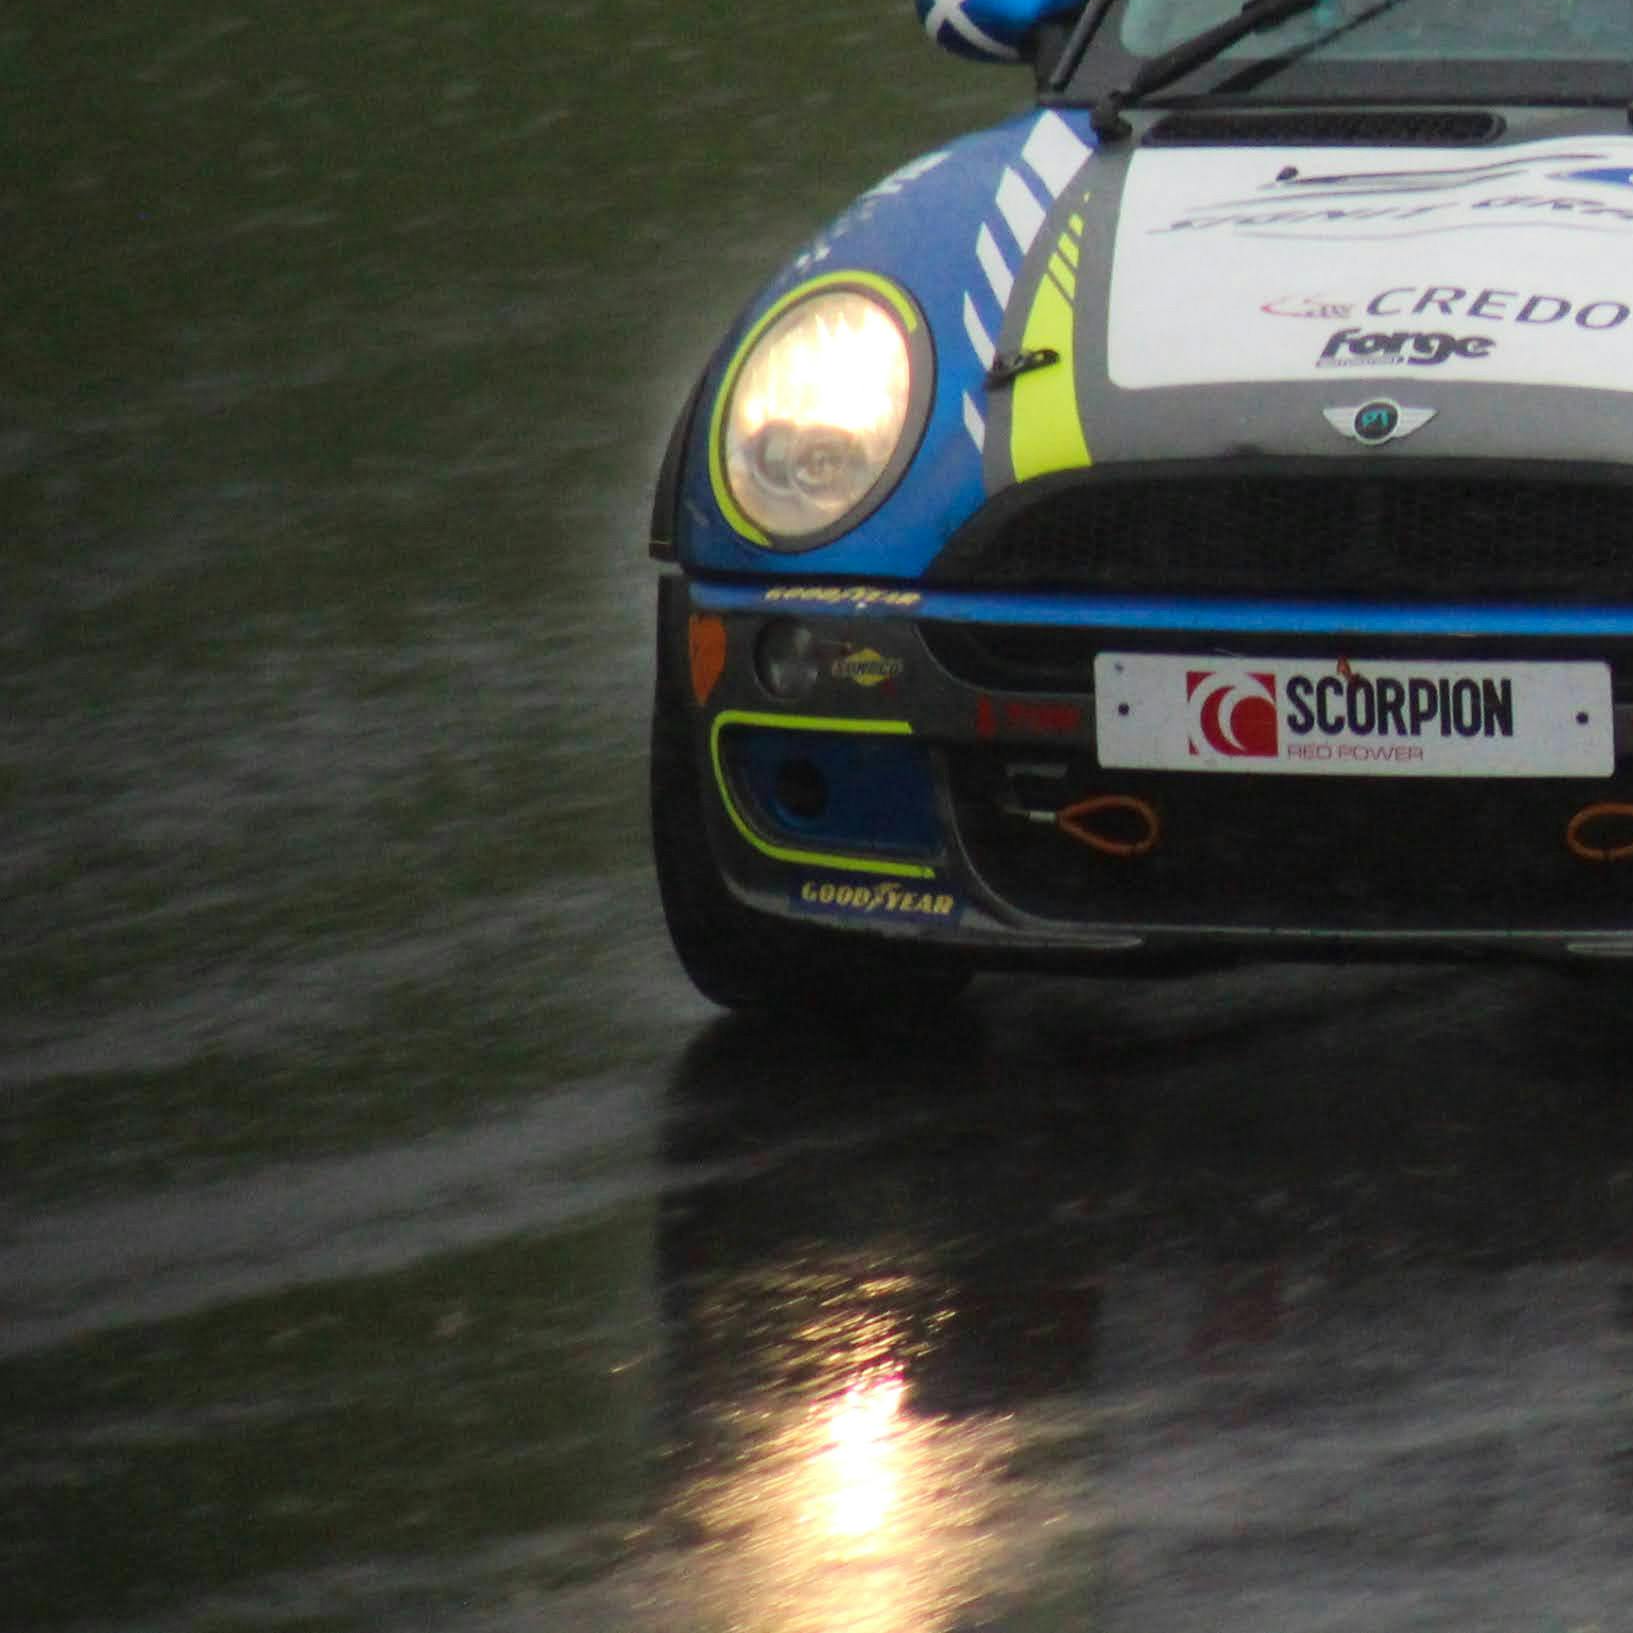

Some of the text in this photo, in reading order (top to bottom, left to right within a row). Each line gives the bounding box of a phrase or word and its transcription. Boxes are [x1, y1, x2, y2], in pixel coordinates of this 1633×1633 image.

[1365, 284, 1631, 330] CREDO
[1318, 325, 1497, 367] forge
[1286, 674, 1515, 738] SCORPION
[1287, 744, 1424, 762] RED POWER
[800, 880, 955, 916] GOODYEAR
